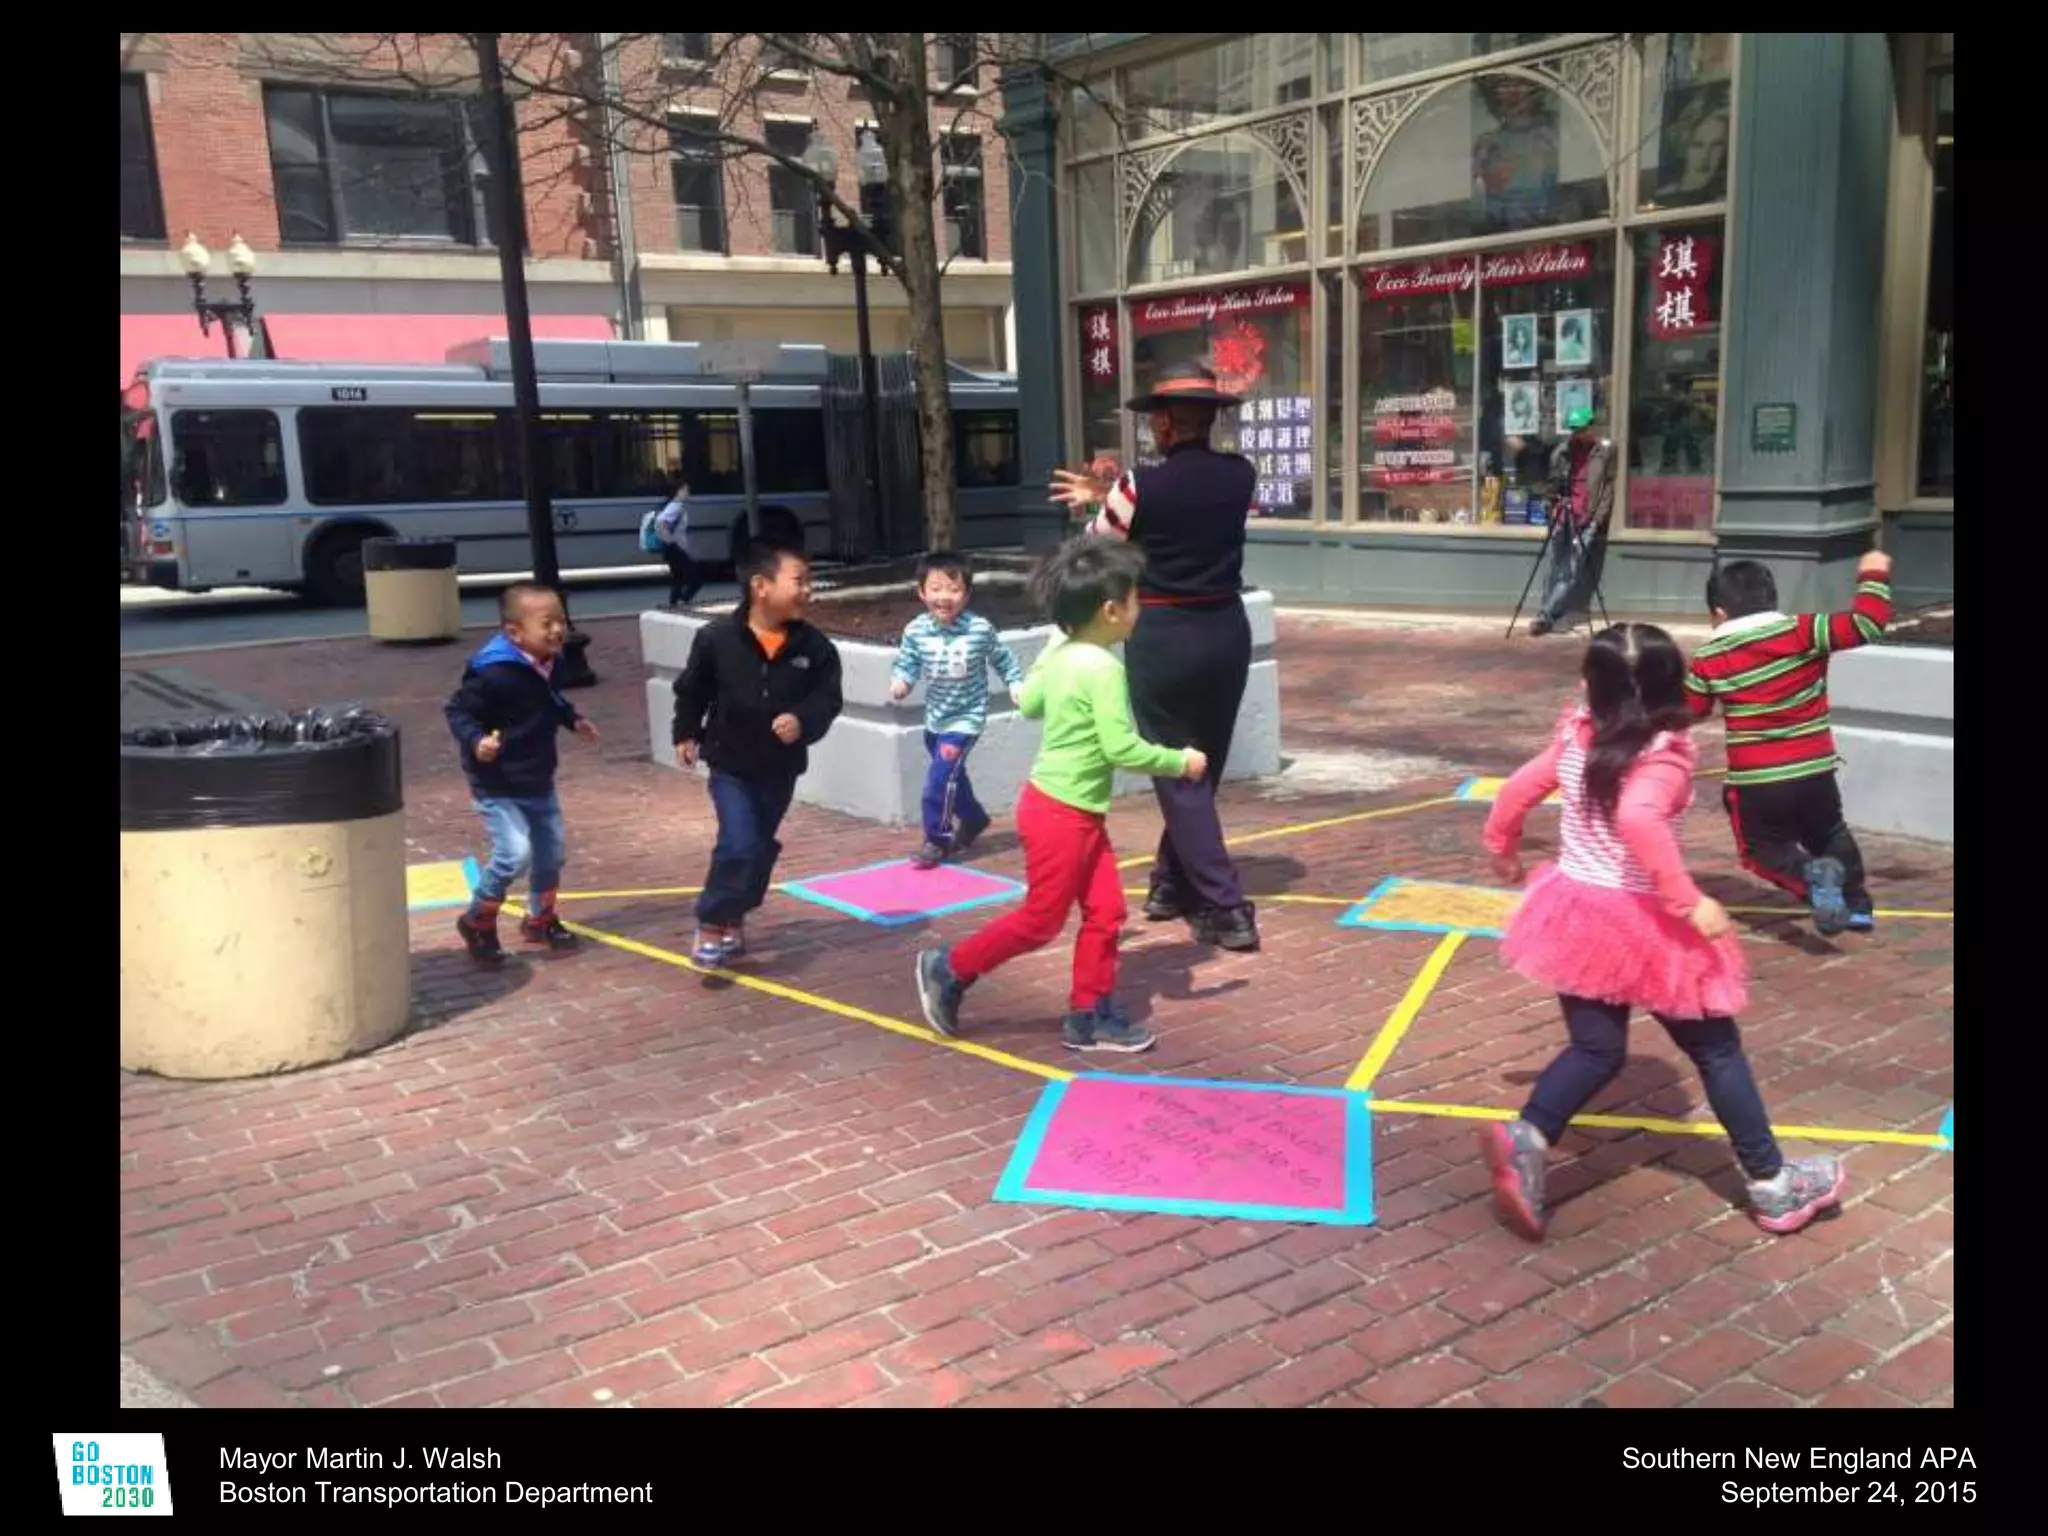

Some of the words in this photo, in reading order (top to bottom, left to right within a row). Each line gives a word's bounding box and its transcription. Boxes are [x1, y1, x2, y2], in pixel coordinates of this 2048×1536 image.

[1411, 263, 1475, 290] Beauty
[1477, 256, 1525, 280] Hair
[1528, 248, 1586, 273] Salon
[1171, 297, 1217, 321] Beauty
[1218, 291, 1252, 312] Hair
[1254, 286, 1295, 306] Salon
